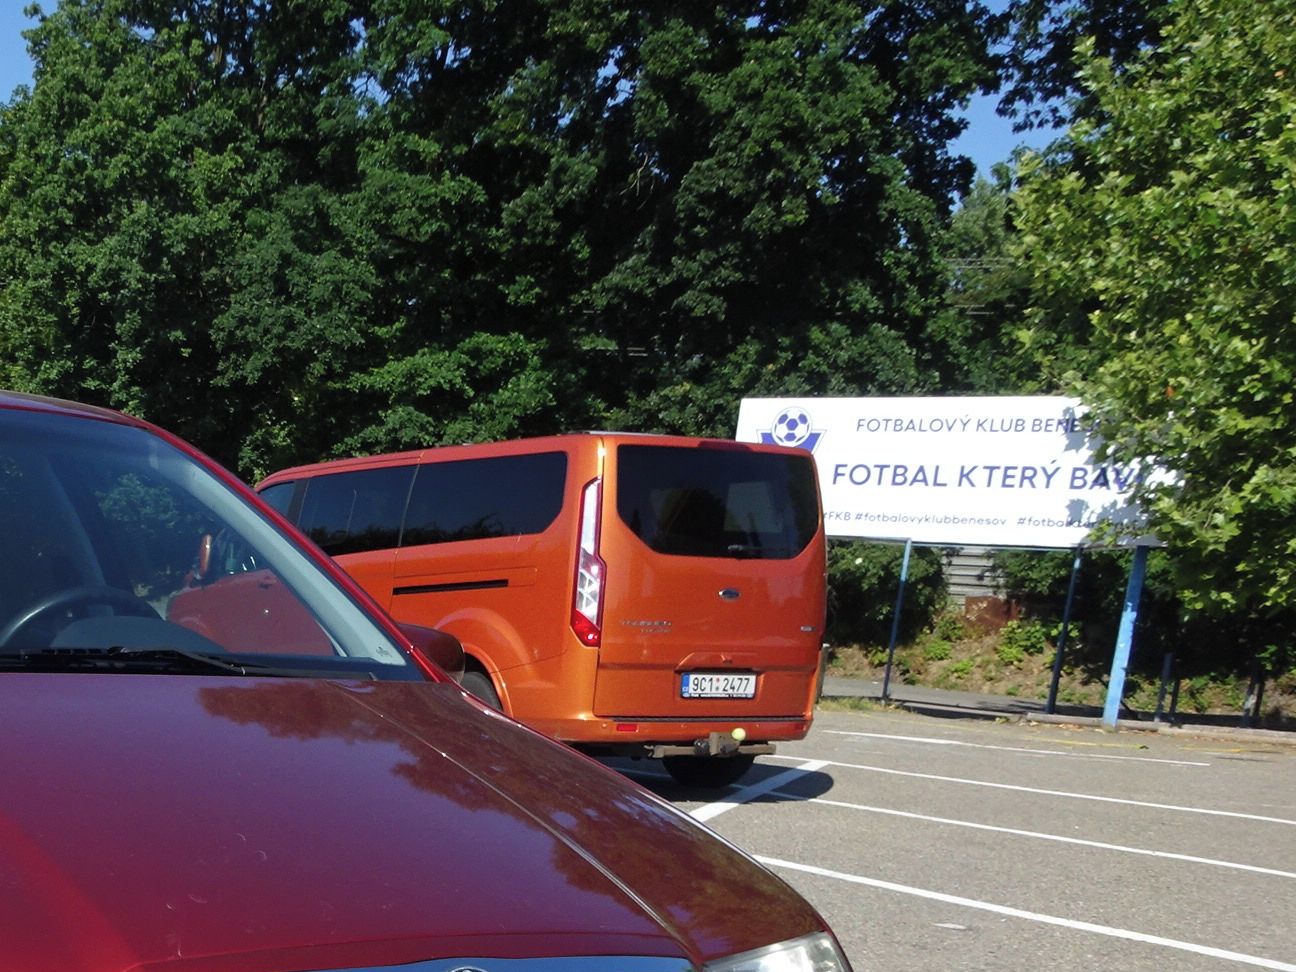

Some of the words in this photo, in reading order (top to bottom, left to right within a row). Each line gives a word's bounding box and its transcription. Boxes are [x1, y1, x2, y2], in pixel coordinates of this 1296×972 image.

[856, 414, 971, 432] FOTBALOVÝ
[976, 418, 1025, 433] KLUB
[832, 463, 947, 487] FOTBAL
[957, 459, 1061, 490] KTERÝ
[855, 512, 1007, 526] #fotbalovyklubbenesov
[692, 677, 713, 692] 9C1
[722, 677, 751, 692] 2477
